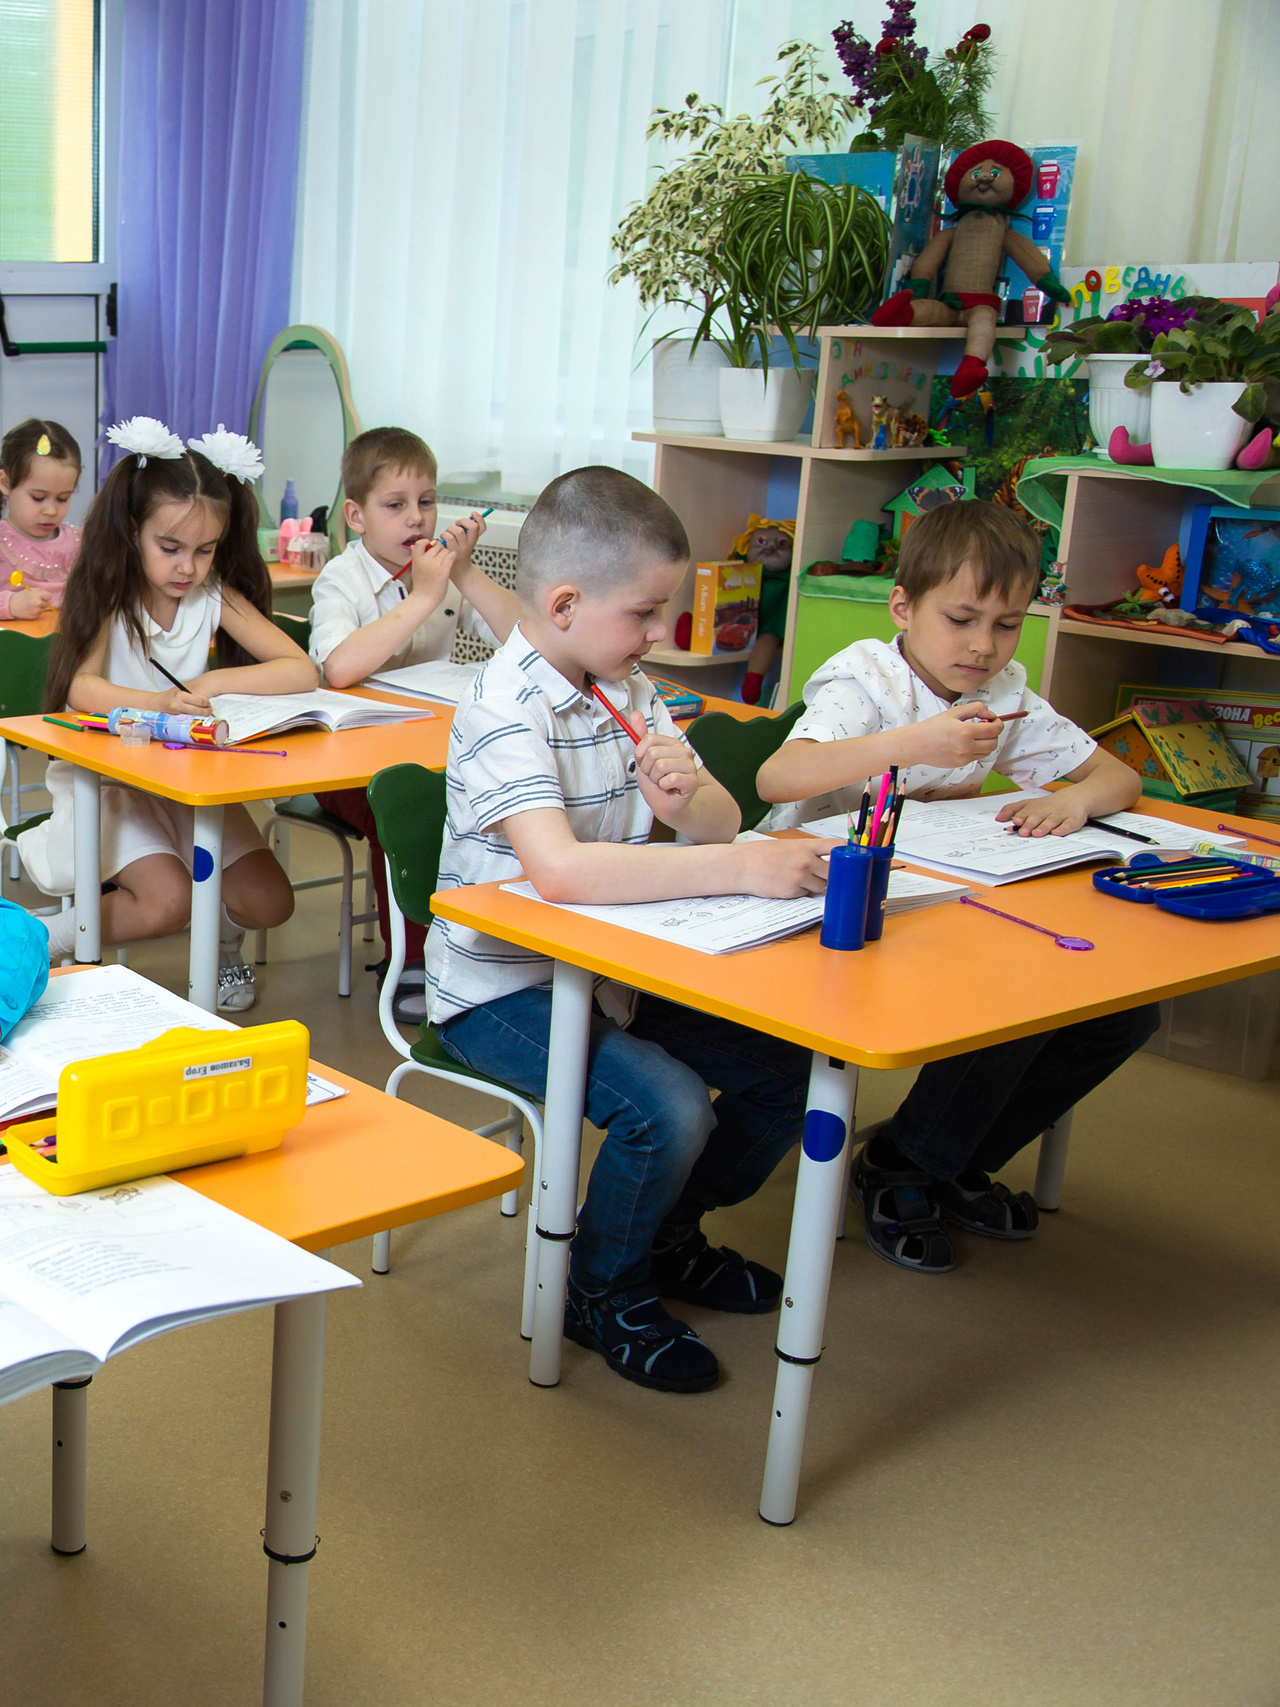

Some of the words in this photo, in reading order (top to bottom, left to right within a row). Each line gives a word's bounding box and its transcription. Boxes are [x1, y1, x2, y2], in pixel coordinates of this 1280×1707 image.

[832, 339, 863, 359] ЭРА
[1211, 705, 1251, 722] ЗОНА
[185, 1066, 208, 1076] Егор
[209, 1058, 251, 1072] Балашов
